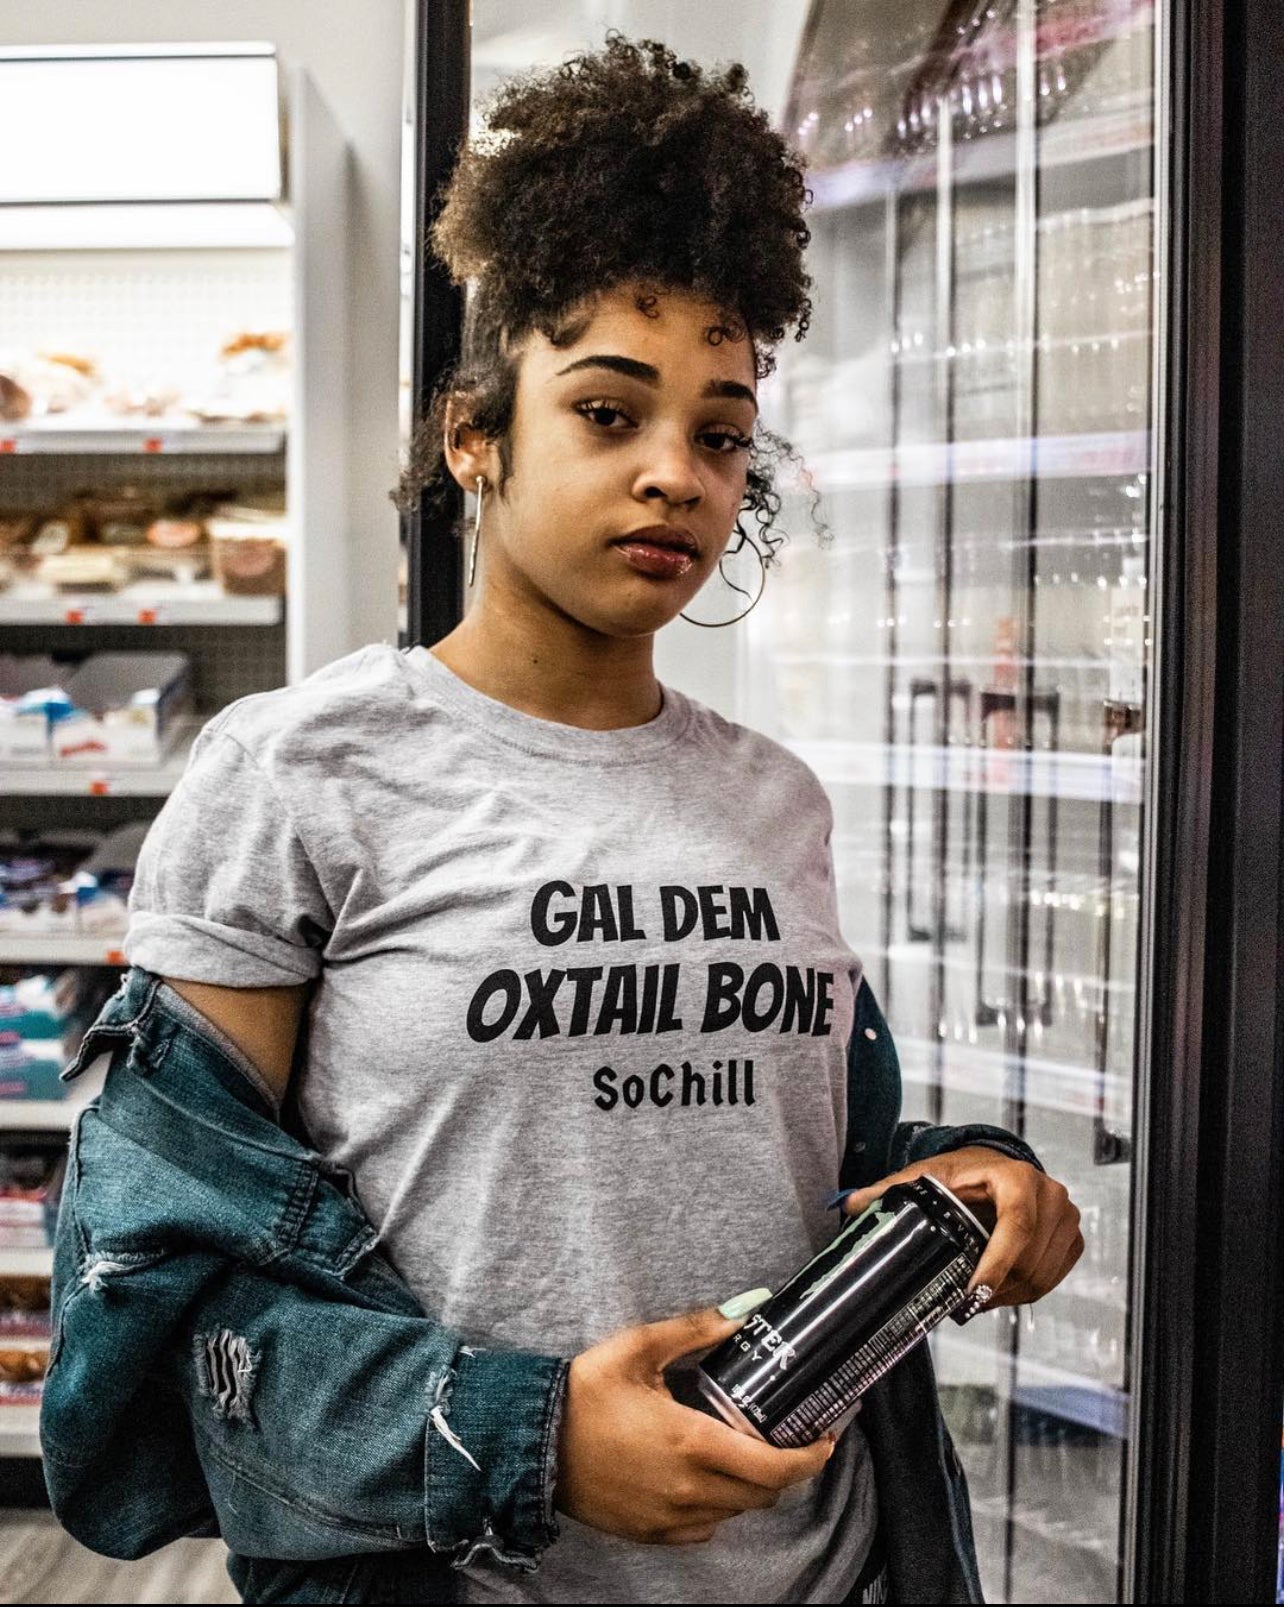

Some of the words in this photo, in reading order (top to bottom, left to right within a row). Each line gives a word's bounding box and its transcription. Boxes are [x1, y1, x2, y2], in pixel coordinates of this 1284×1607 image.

[531, 881, 646, 946] GAL
[660, 885, 780, 941] DEM
[467, 964, 683, 1042] OXTAIL
[700, 962, 833, 1037] BONE
[593, 1060, 755, 1111] SoChill
[733, 1333, 763, 1362] RGY
[743, 1313, 796, 1370] STER
